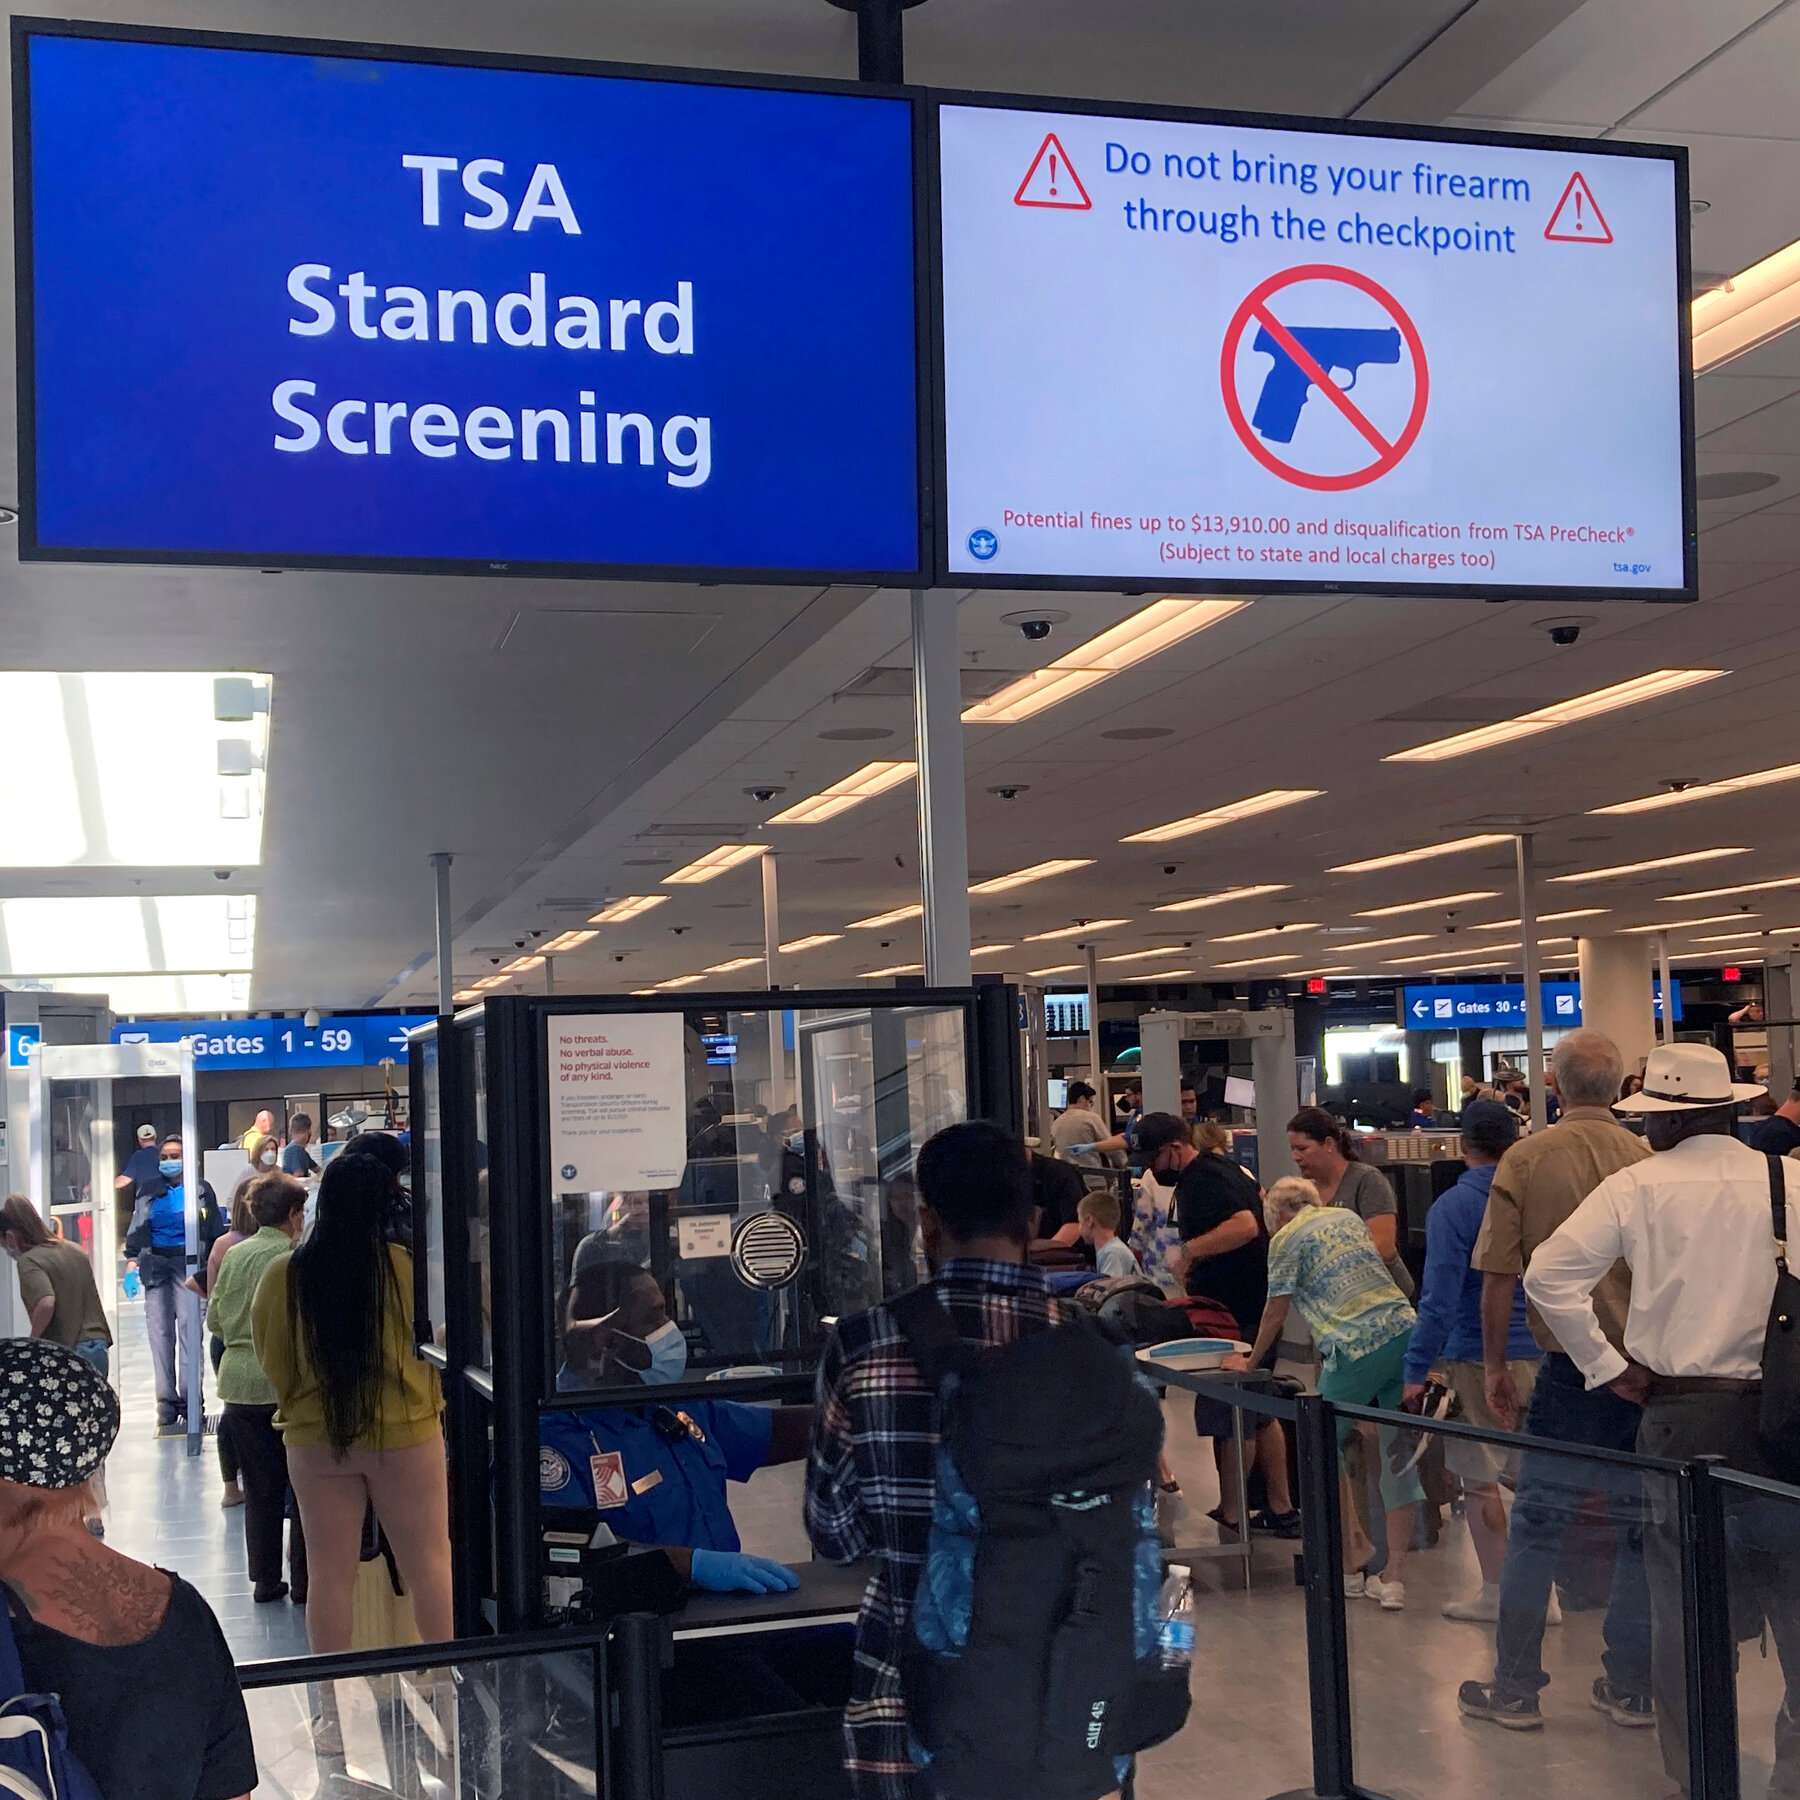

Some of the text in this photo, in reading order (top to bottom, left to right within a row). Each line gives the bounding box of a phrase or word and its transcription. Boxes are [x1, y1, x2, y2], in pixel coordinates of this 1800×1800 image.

[1105, 142, 1530, 202] Do not bring your firearm
[402, 154, 582, 236] TSA
[1123, 198, 1516, 256] through the checkpoint
[287, 263, 695, 355] Standard
[272, 380, 712, 488] Screening
[1004, 509, 1083, 530] Potential
[1090, 511, 1132, 531] fines
[1139, 517, 1161, 535] up
[1167, 516, 1186, 532] to
[1191, 514, 1290, 536] $13,910.00
[1296, 518, 1328, 535] and
[1334, 519, 1461, 541] disqualification
[1468, 522, 1508, 541] from
[1513, 525, 1545, 541] TSA
[1159, 543, 1496, 572] (Subject to state and local charges too)
[1613, 561, 1651, 575] tsa.gov
[1456, 1002, 1491, 1014] Gates
[1495, 1000, 1510, 1013] 30
[1520, 1000, 1527, 1012] 5
[18, 1035, 32, 1056] 6
[193, 1034, 265, 1056] Gates
[281, 1030, 294, 1053] 1
[321, 1029, 352, 1052] 59
[560, 1035, 608, 1045] No threats.
[560, 1048, 634, 1058] No verbal abuse.
[560, 1060, 651, 1073] No physical violence
[560, 1071, 613, 1083] of any kind.
[1091, 1701, 1105, 1719] 45
